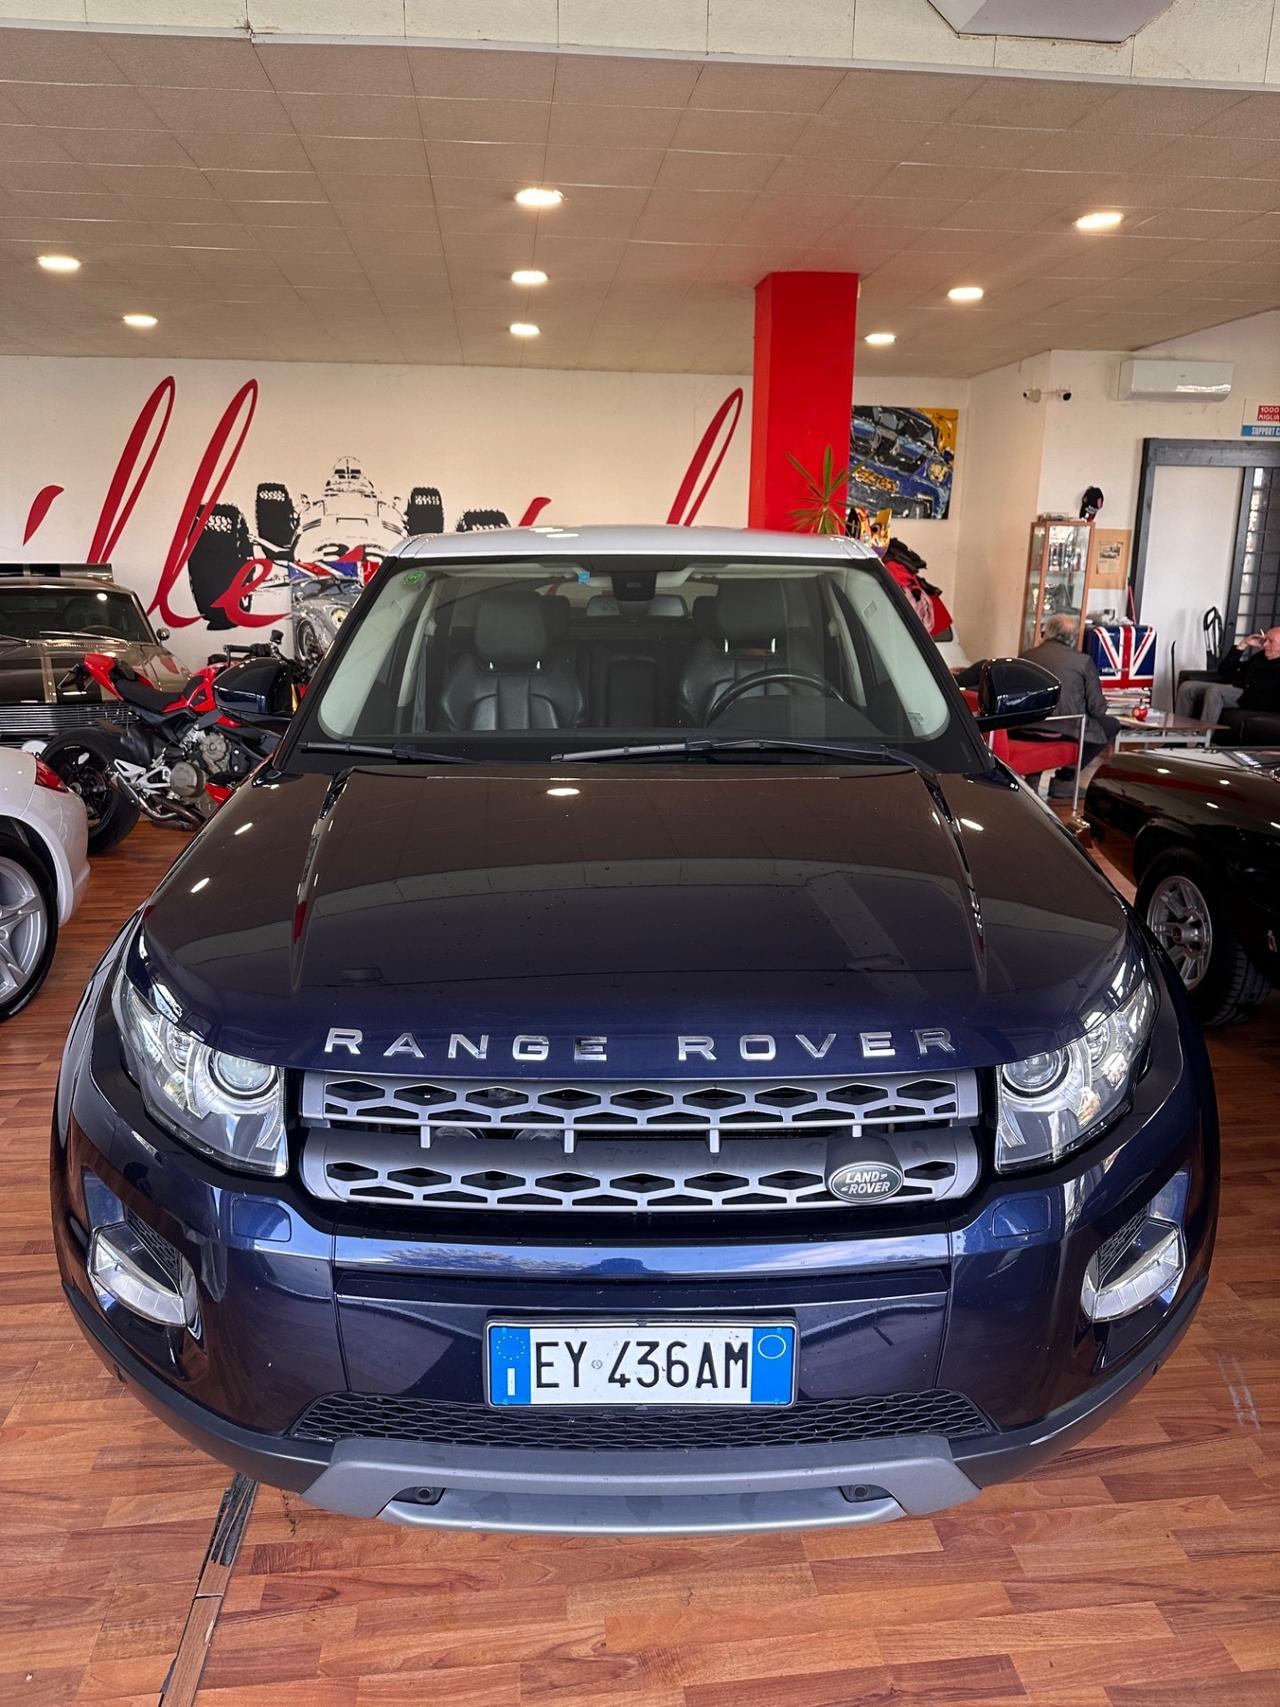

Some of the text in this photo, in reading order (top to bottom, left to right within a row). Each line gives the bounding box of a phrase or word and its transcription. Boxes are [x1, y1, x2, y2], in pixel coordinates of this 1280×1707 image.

[1260, 406, 1280, 414] 1000
[1251, 426, 1275, 436] SUPPORT
[323, 1027, 956, 1062] RANGE ROVER
[845, 1171, 880, 1183] LAND
[848, 1181, 890, 1194] ROVER
[535, 1341, 750, 1389] EY 436AM
